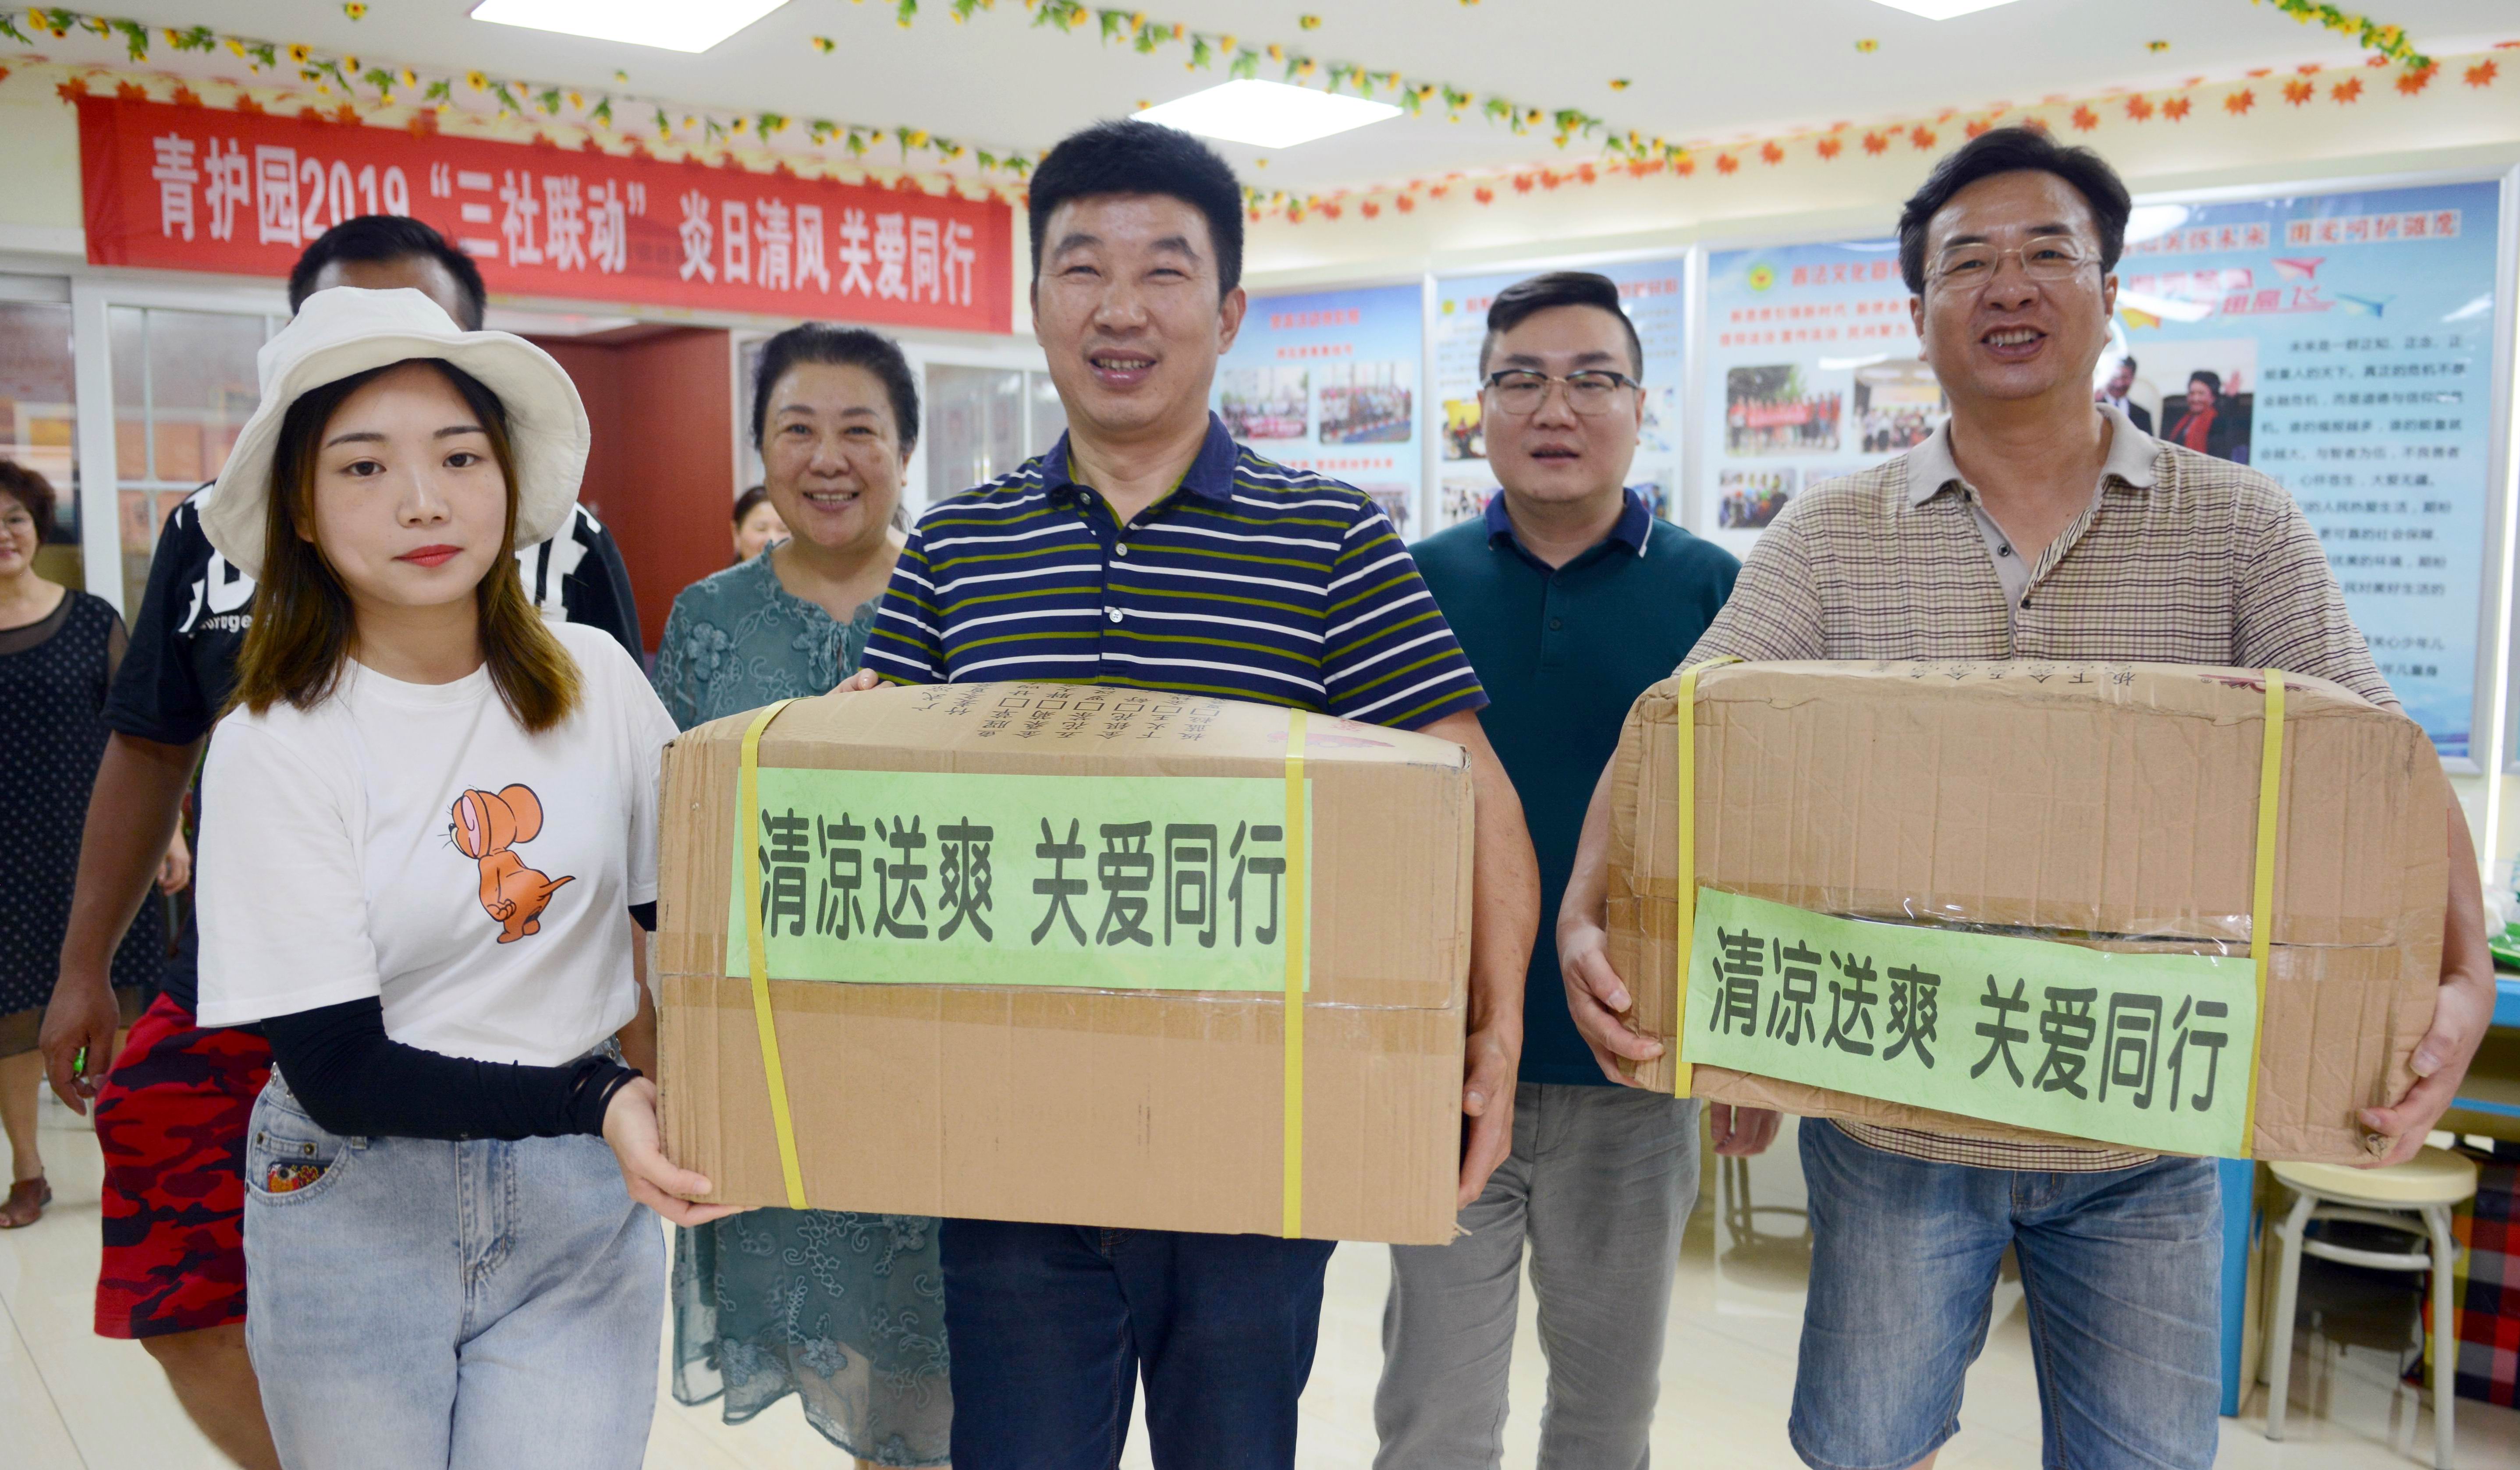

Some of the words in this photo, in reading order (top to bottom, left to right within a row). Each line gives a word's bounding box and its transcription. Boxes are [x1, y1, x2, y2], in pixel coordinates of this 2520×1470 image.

[758, 808, 993, 942] 清凉送爽
[1032, 817, 1287, 948] 关爱同行
[1709, 926, 1941, 1069] 清凉送爽
[1970, 974, 2229, 1113] 关爱同行
